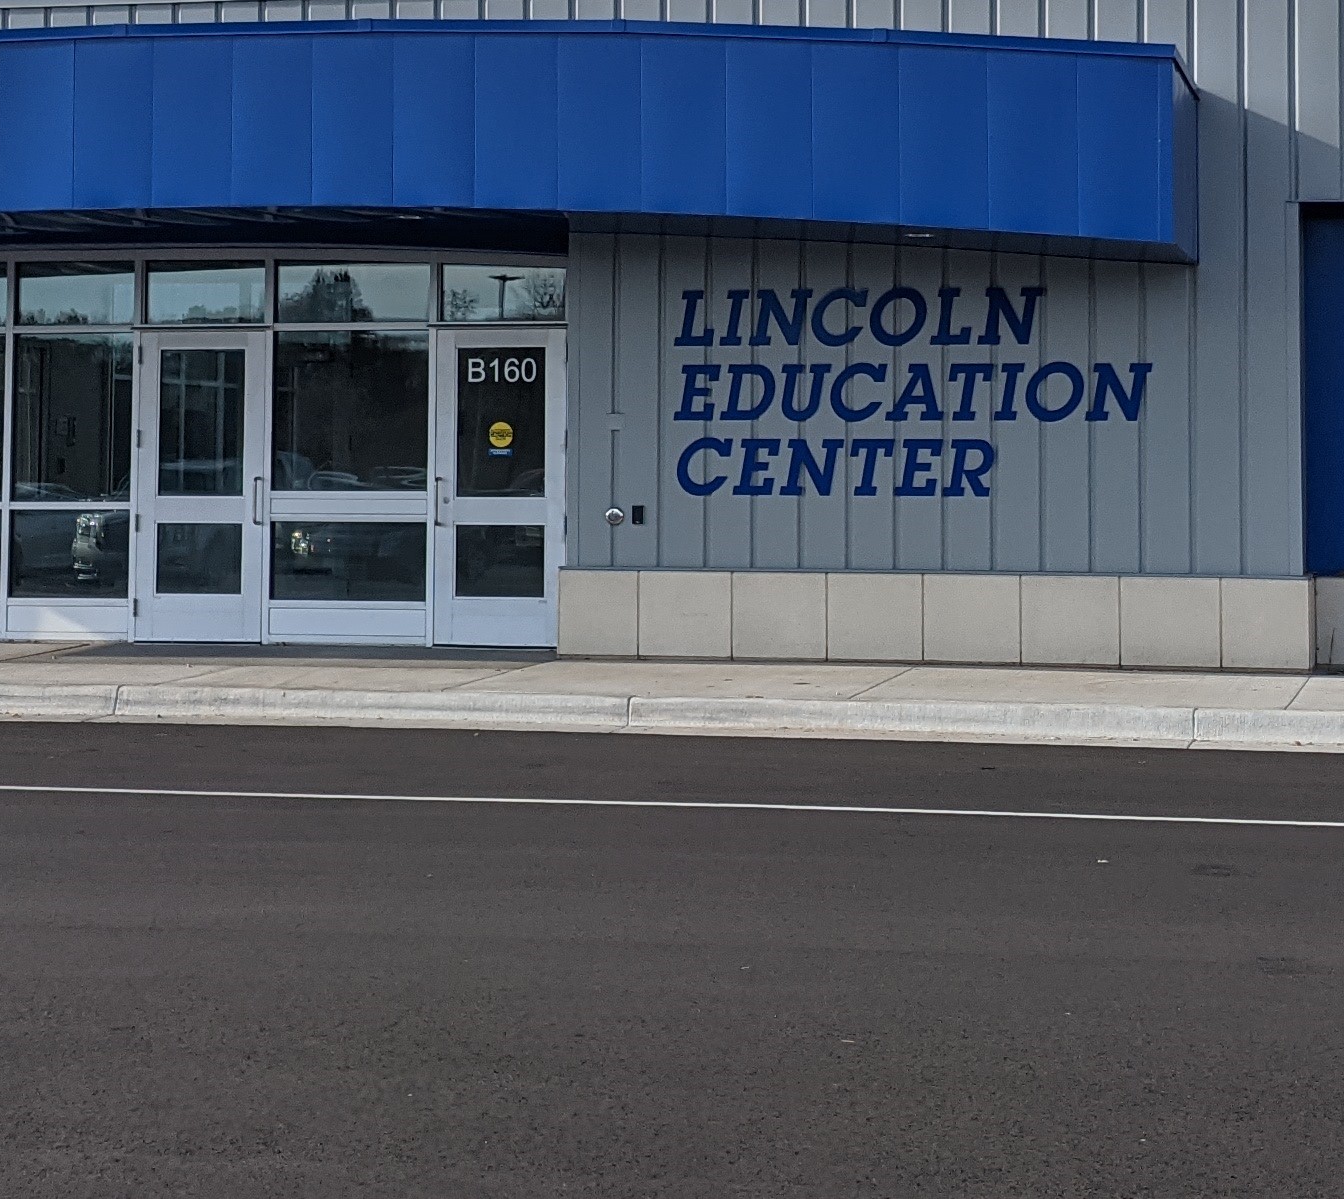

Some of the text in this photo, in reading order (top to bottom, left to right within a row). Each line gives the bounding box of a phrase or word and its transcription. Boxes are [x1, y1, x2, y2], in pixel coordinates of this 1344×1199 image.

[673, 287, 1046, 347] LINCOLN
[467, 358, 537, 383] B160
[673, 362, 1153, 422] EDUCATION
[676, 437, 995, 497] CENTER
